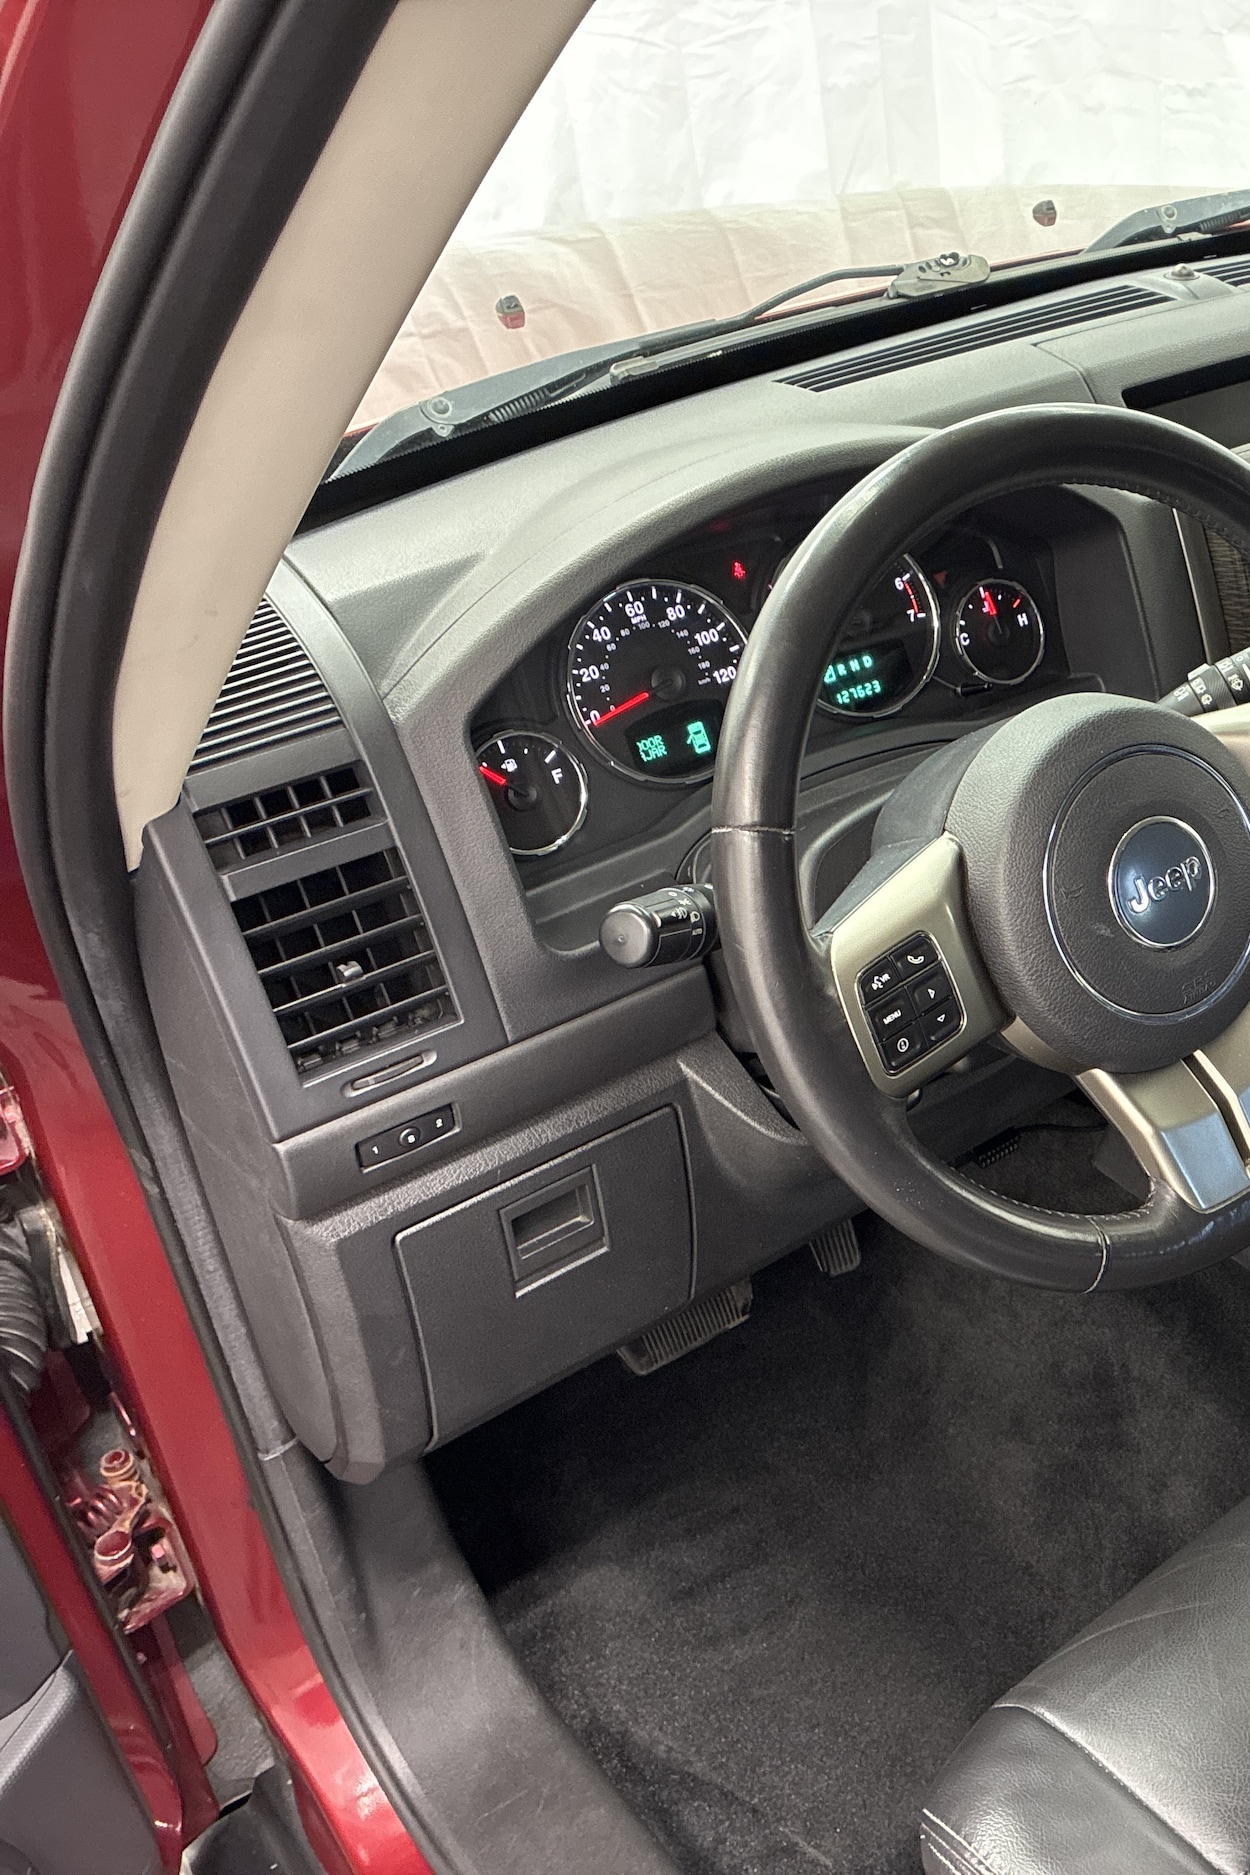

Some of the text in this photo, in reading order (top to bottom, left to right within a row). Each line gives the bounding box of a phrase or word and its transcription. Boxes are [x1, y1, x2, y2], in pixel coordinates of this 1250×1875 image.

[895, 577, 904, 590] 6
[625, 601, 644, 617] 60
[666, 605, 685, 620] 80
[907, 610, 916, 622] 7
[631, 614, 647, 625] MPH
[638, 622, 650, 630] 100
[658, 620, 670, 629] 120
[1017, 613, 1029, 627] H
[592, 626, 611, 642] 40
[676, 629, 689, 638] 140
[694, 628, 719, 646] 100
[960, 632, 970, 646] C
[607, 643, 616, 651] 60
[580, 665, 600, 682] 20
[600, 663, 610, 671] 40
[713, 666, 737, 684] 120
[600, 684, 610, 693] 20
[836, 679, 881, 704] 127623
[589, 710, 601, 724] 0
[551, 768, 563, 784] F
[1128, 856, 1201, 913] Jeep
[883, 1009, 901, 1025] MENU
[435, 1118, 443, 1129] 2
[372, 1145, 379, 1155] 1
